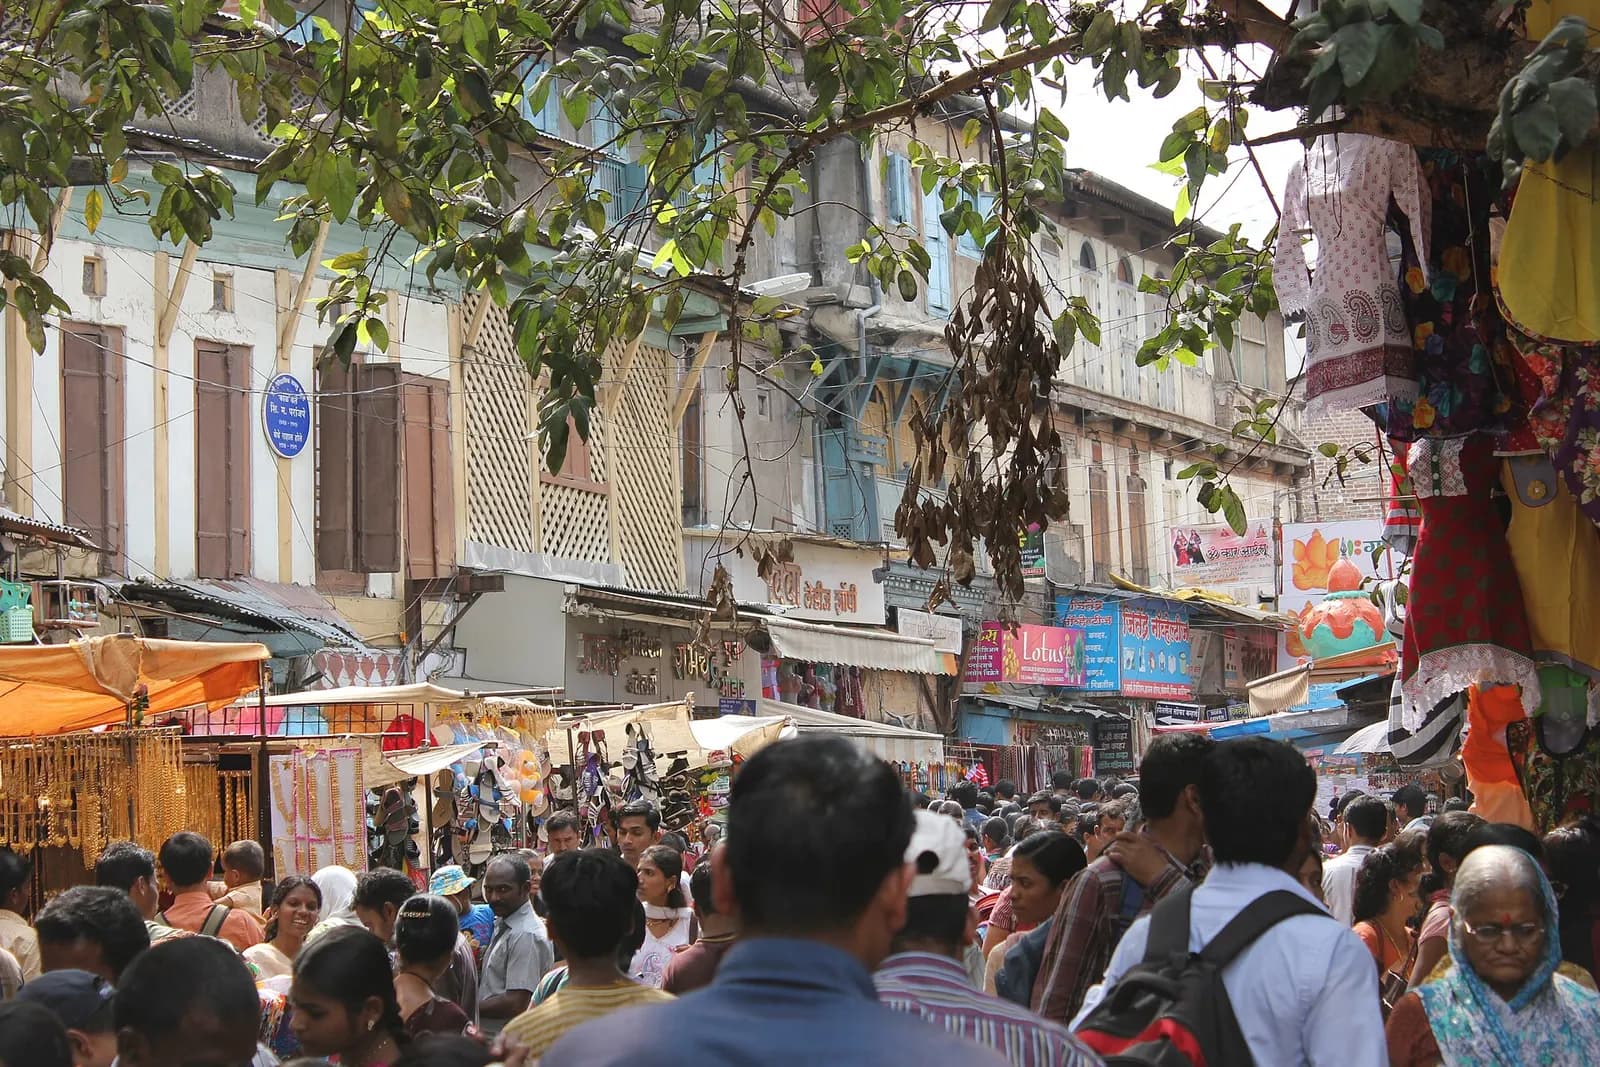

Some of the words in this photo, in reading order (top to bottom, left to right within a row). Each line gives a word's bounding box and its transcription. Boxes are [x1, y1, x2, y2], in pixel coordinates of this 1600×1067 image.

[804, 580, 831, 611] लेडीज
[1122, 604, 1150, 640] जितेंद्र
[1023, 631, 1064, 663] Lotus
